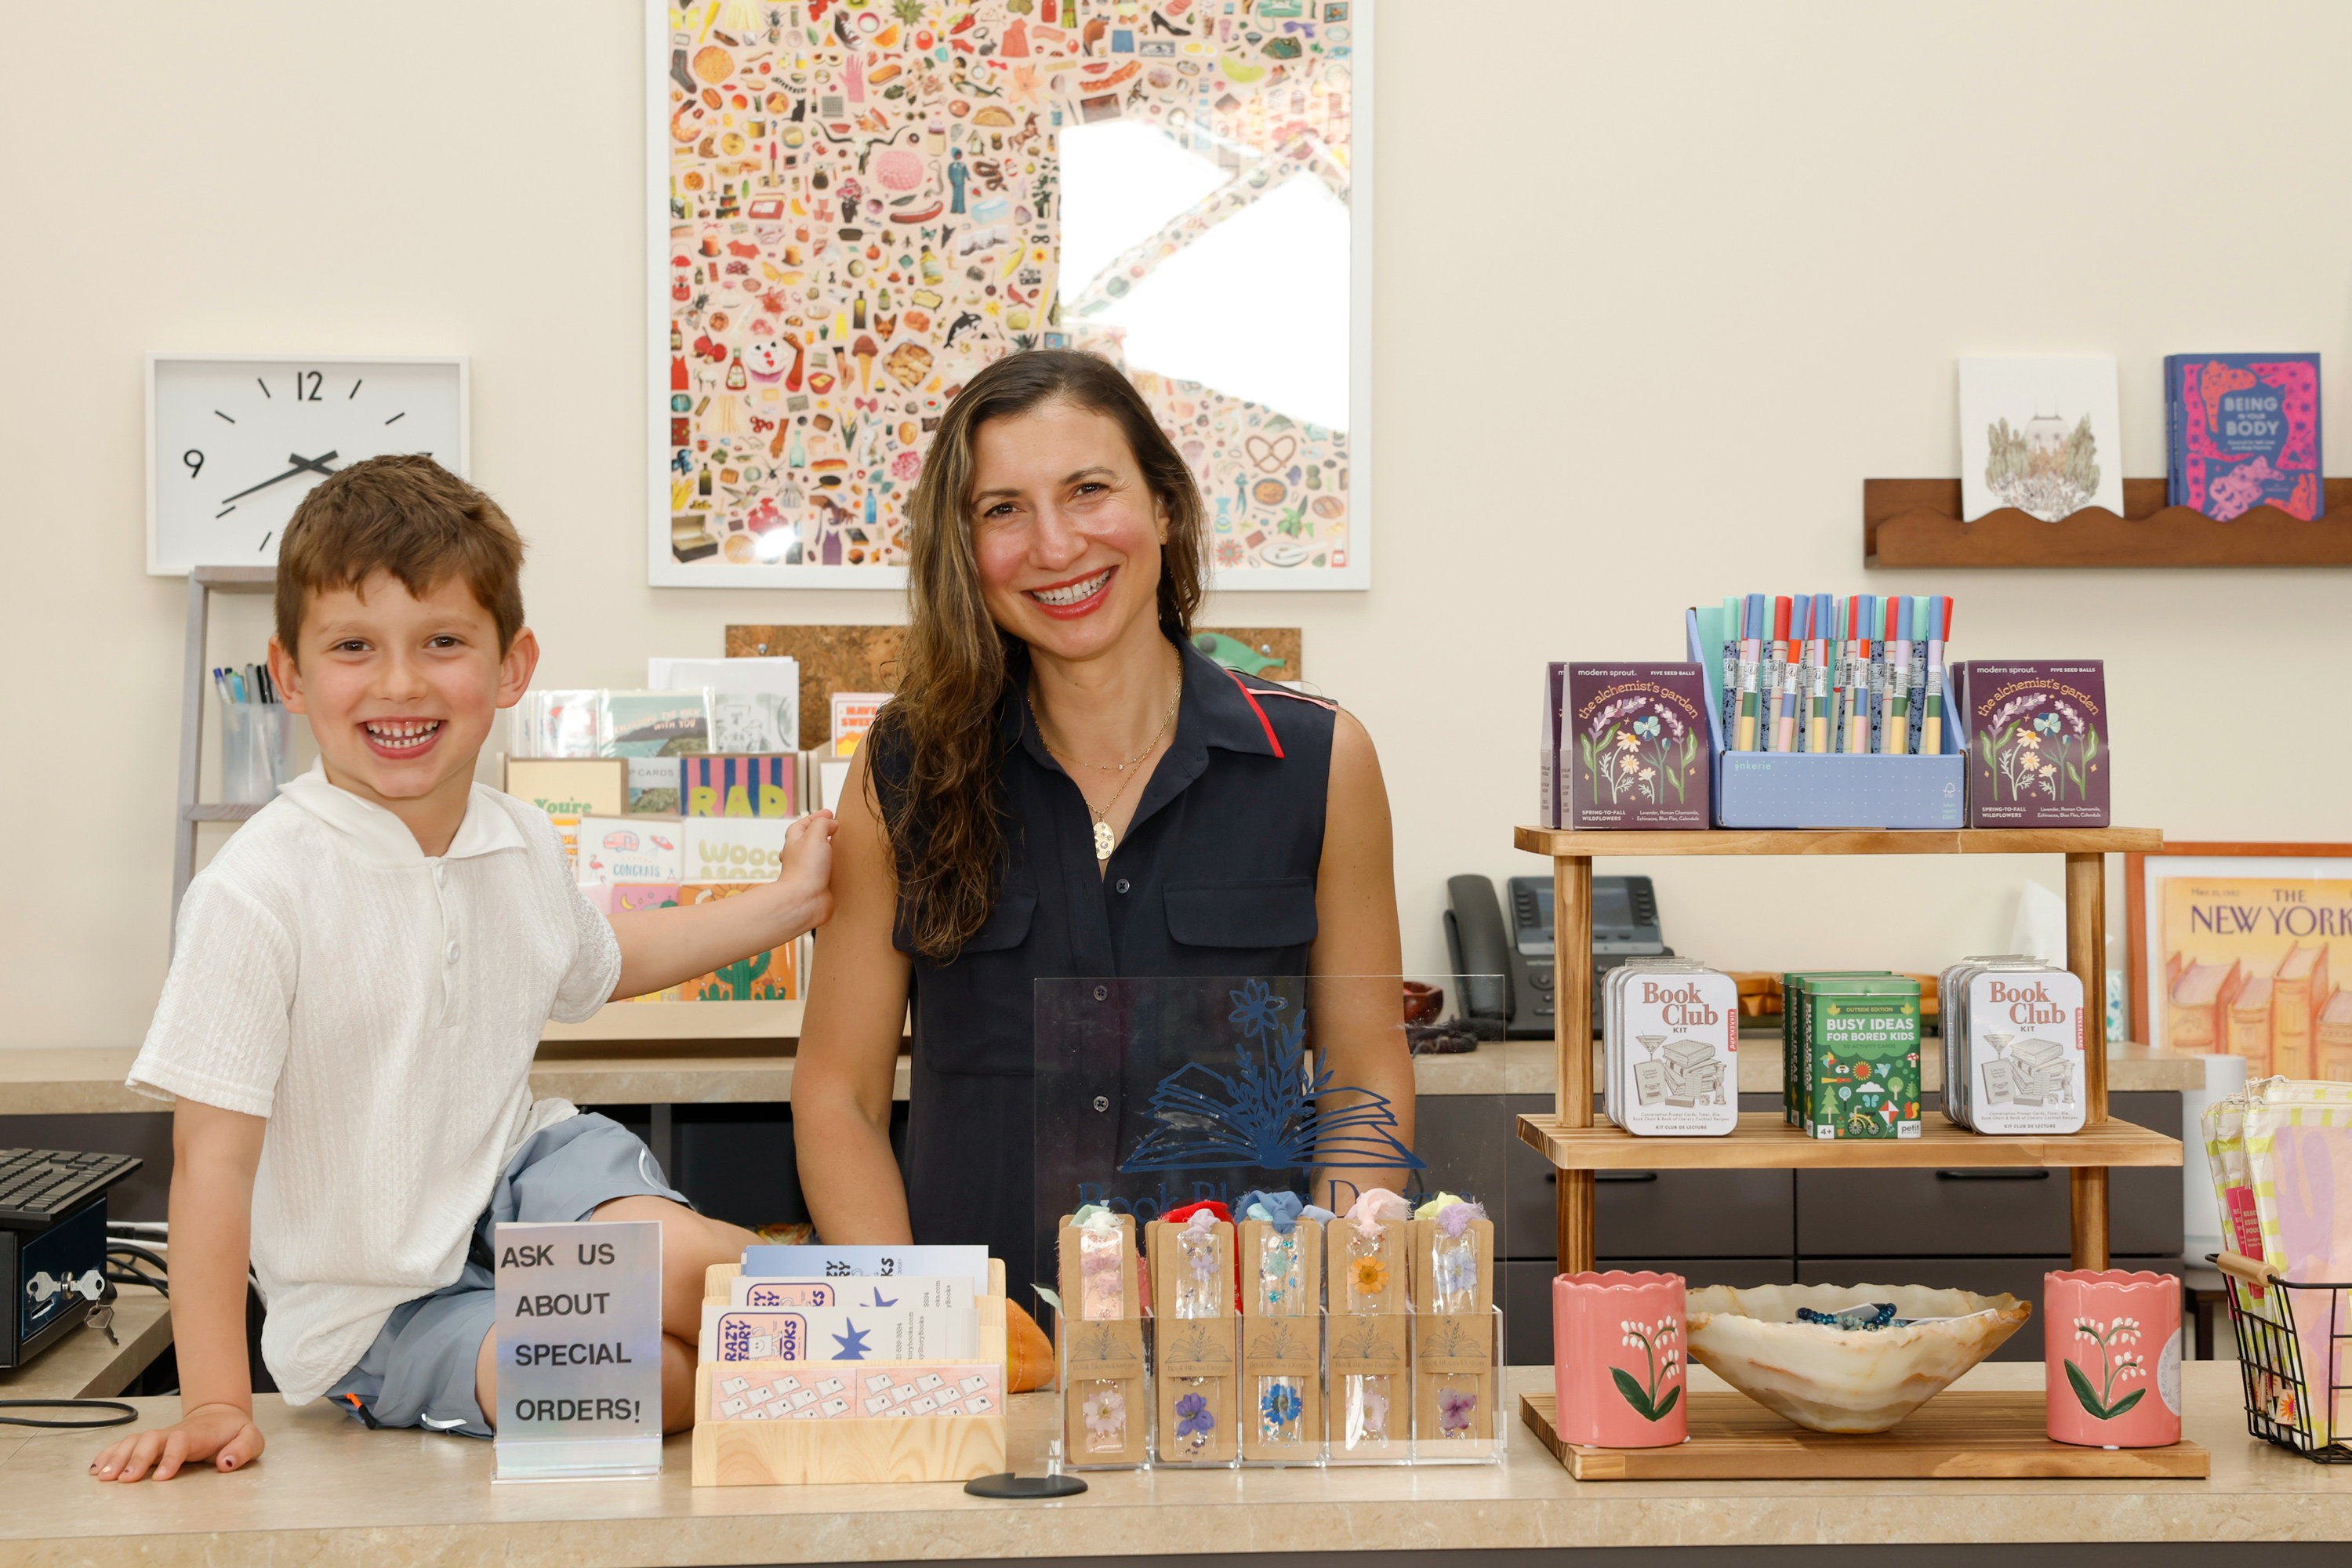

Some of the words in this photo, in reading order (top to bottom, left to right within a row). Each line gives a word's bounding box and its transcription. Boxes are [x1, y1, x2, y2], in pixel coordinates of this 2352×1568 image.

[297, 371, 323, 401] 12
[2224, 397, 2278, 412] BEING
[2225, 420, 2280, 436] BODY
[183, 449, 205, 478] 9
[1578, 701, 1596, 720] the
[1594, 681, 1661, 703] alchemist's
[1661, 687, 1699, 720] garden
[1977, 699, 1996, 717] the
[1994, 677, 2060, 702] alchemist's
[2060, 684, 2100, 716] garden
[653, 720, 676, 731] WITH
[678, 717, 696, 729] YOU
[637, 768, 675, 777] CARDS
[534, 797, 593, 815] You're
[690, 783, 789, 817] RAD
[613, 863, 661, 878] CONGRATS
[2272, 889, 2307, 902] THE
[2191, 905, 2262, 935] NEW
[1642, 982, 1704, 1004] Book
[1989, 981, 2051, 1003] Book
[1662, 1004, 1719, 1026] Club
[1826, 1018, 1867, 1031] BUSY
[1870, 1018, 1915, 1030] IDEAS
[2009, 1002, 2066, 1025] Club
[1826, 1033, 1849, 1041] FOR
[1850, 1033, 1887, 1041] BORED
[1890, 1032, 1915, 1041] KIDS
[1901, 1123, 1919, 1134] petit
[500, 1244, 555, 1269] ASK
[577, 1243, 616, 1266] US
[514, 1292, 611, 1317] ABOUT
[514, 1341, 633, 1367] SPECIAL
[515, 1398, 641, 1424] ORDERS!
